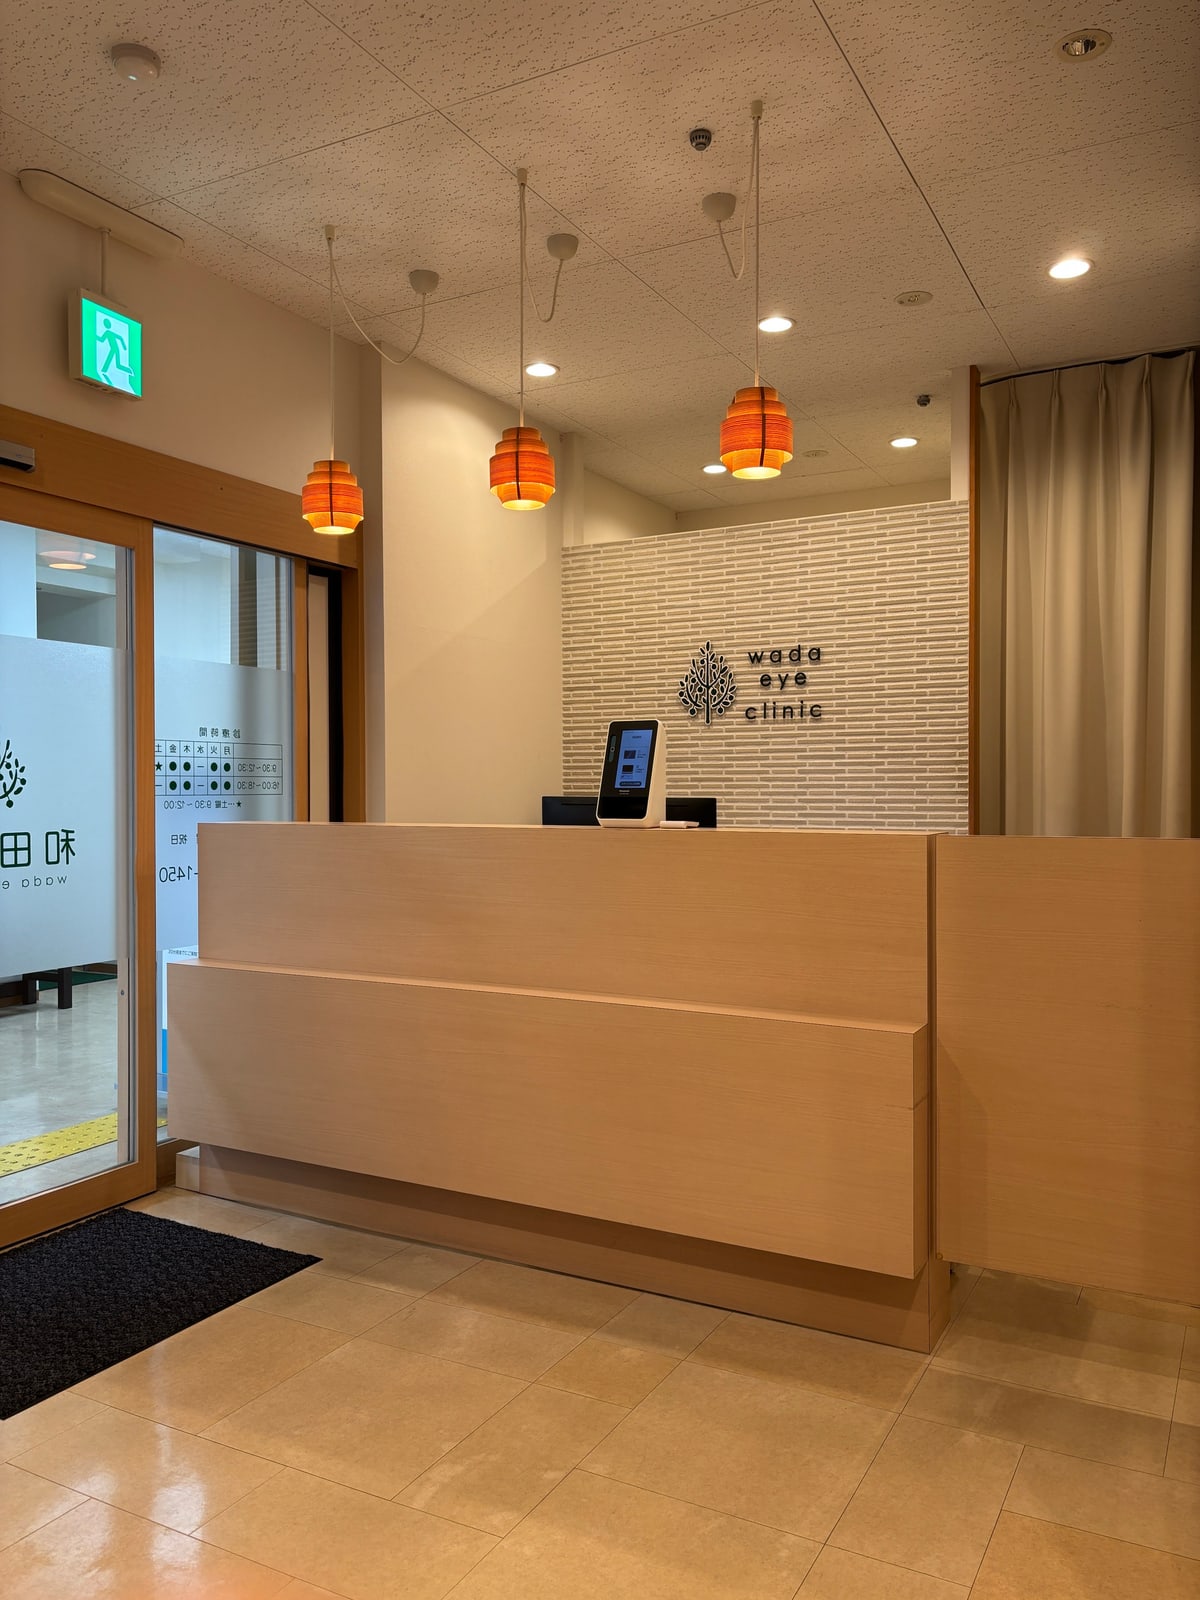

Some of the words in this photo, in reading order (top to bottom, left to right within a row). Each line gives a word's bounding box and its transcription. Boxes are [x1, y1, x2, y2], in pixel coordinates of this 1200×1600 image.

[747, 644, 821, 664] wada
[759, 671, 807, 690] eye
[744, 700, 822, 719] clinic
